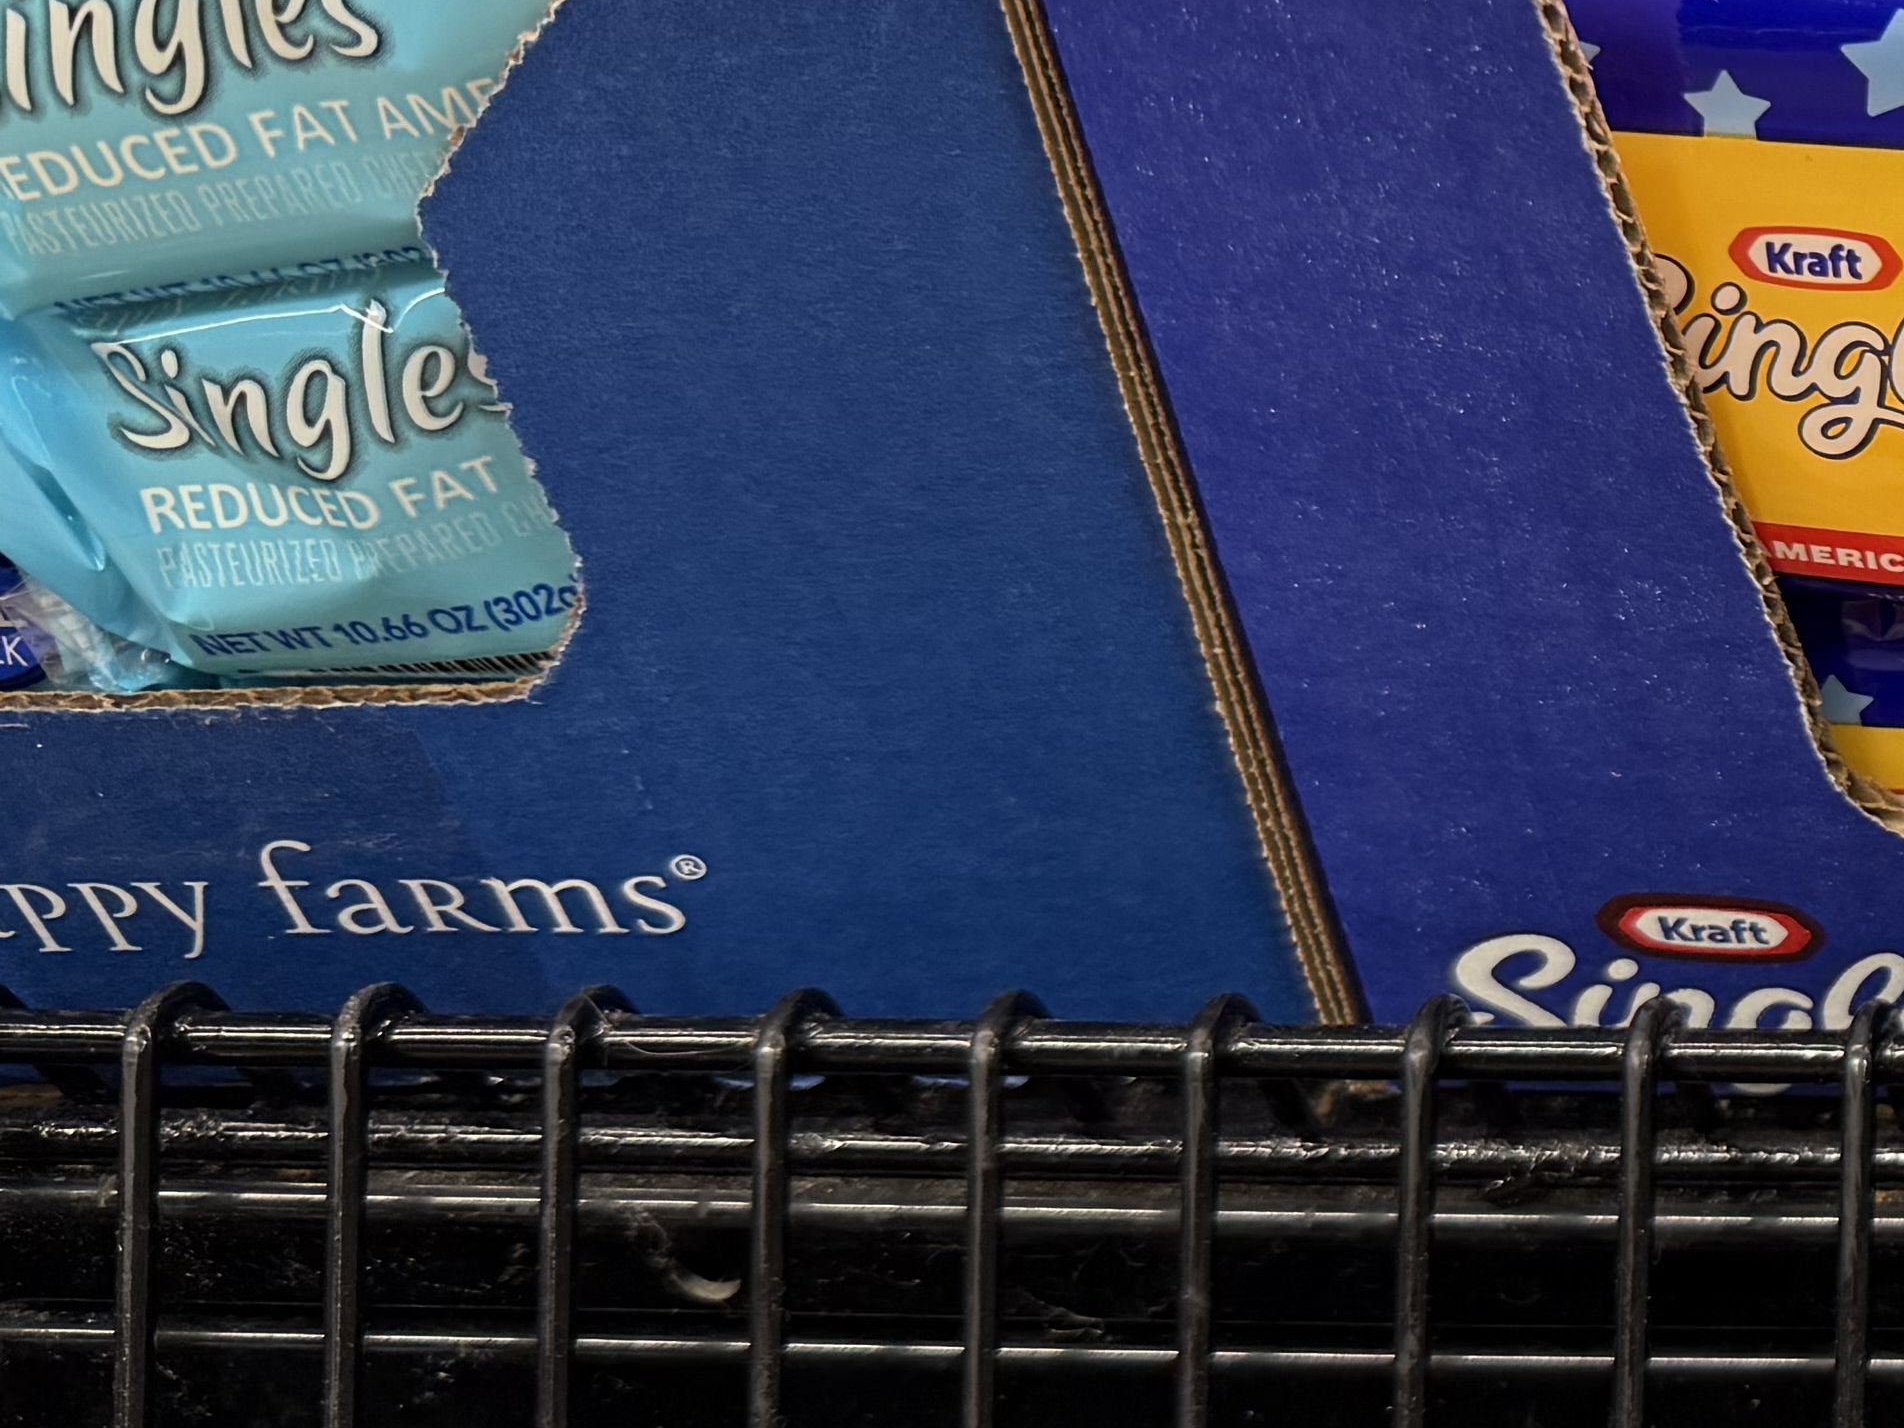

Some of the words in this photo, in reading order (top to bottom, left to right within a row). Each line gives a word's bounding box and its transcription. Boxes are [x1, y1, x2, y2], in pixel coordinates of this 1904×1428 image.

[248, 99, 358, 160] FAT
[4, 188, 202, 256] PASTEURIZED
[200, 158, 363, 228] PREPARED
[1764, 240, 1864, 283] Kraft
[92, 298, 466, 480] Single
[140, 483, 380, 535] REDUCED
[389, 456, 500, 518] FAT
[159, 538, 344, 590] PASTEURIZED
[349, 508, 499, 580] PREPARED
[196, 631, 271, 657] NET
[270, 625, 328, 650] WT
[333, 615, 430, 648] 10.66
[430, 605, 488, 636] OZ
[1657, 915, 1771, 947] Kraft
